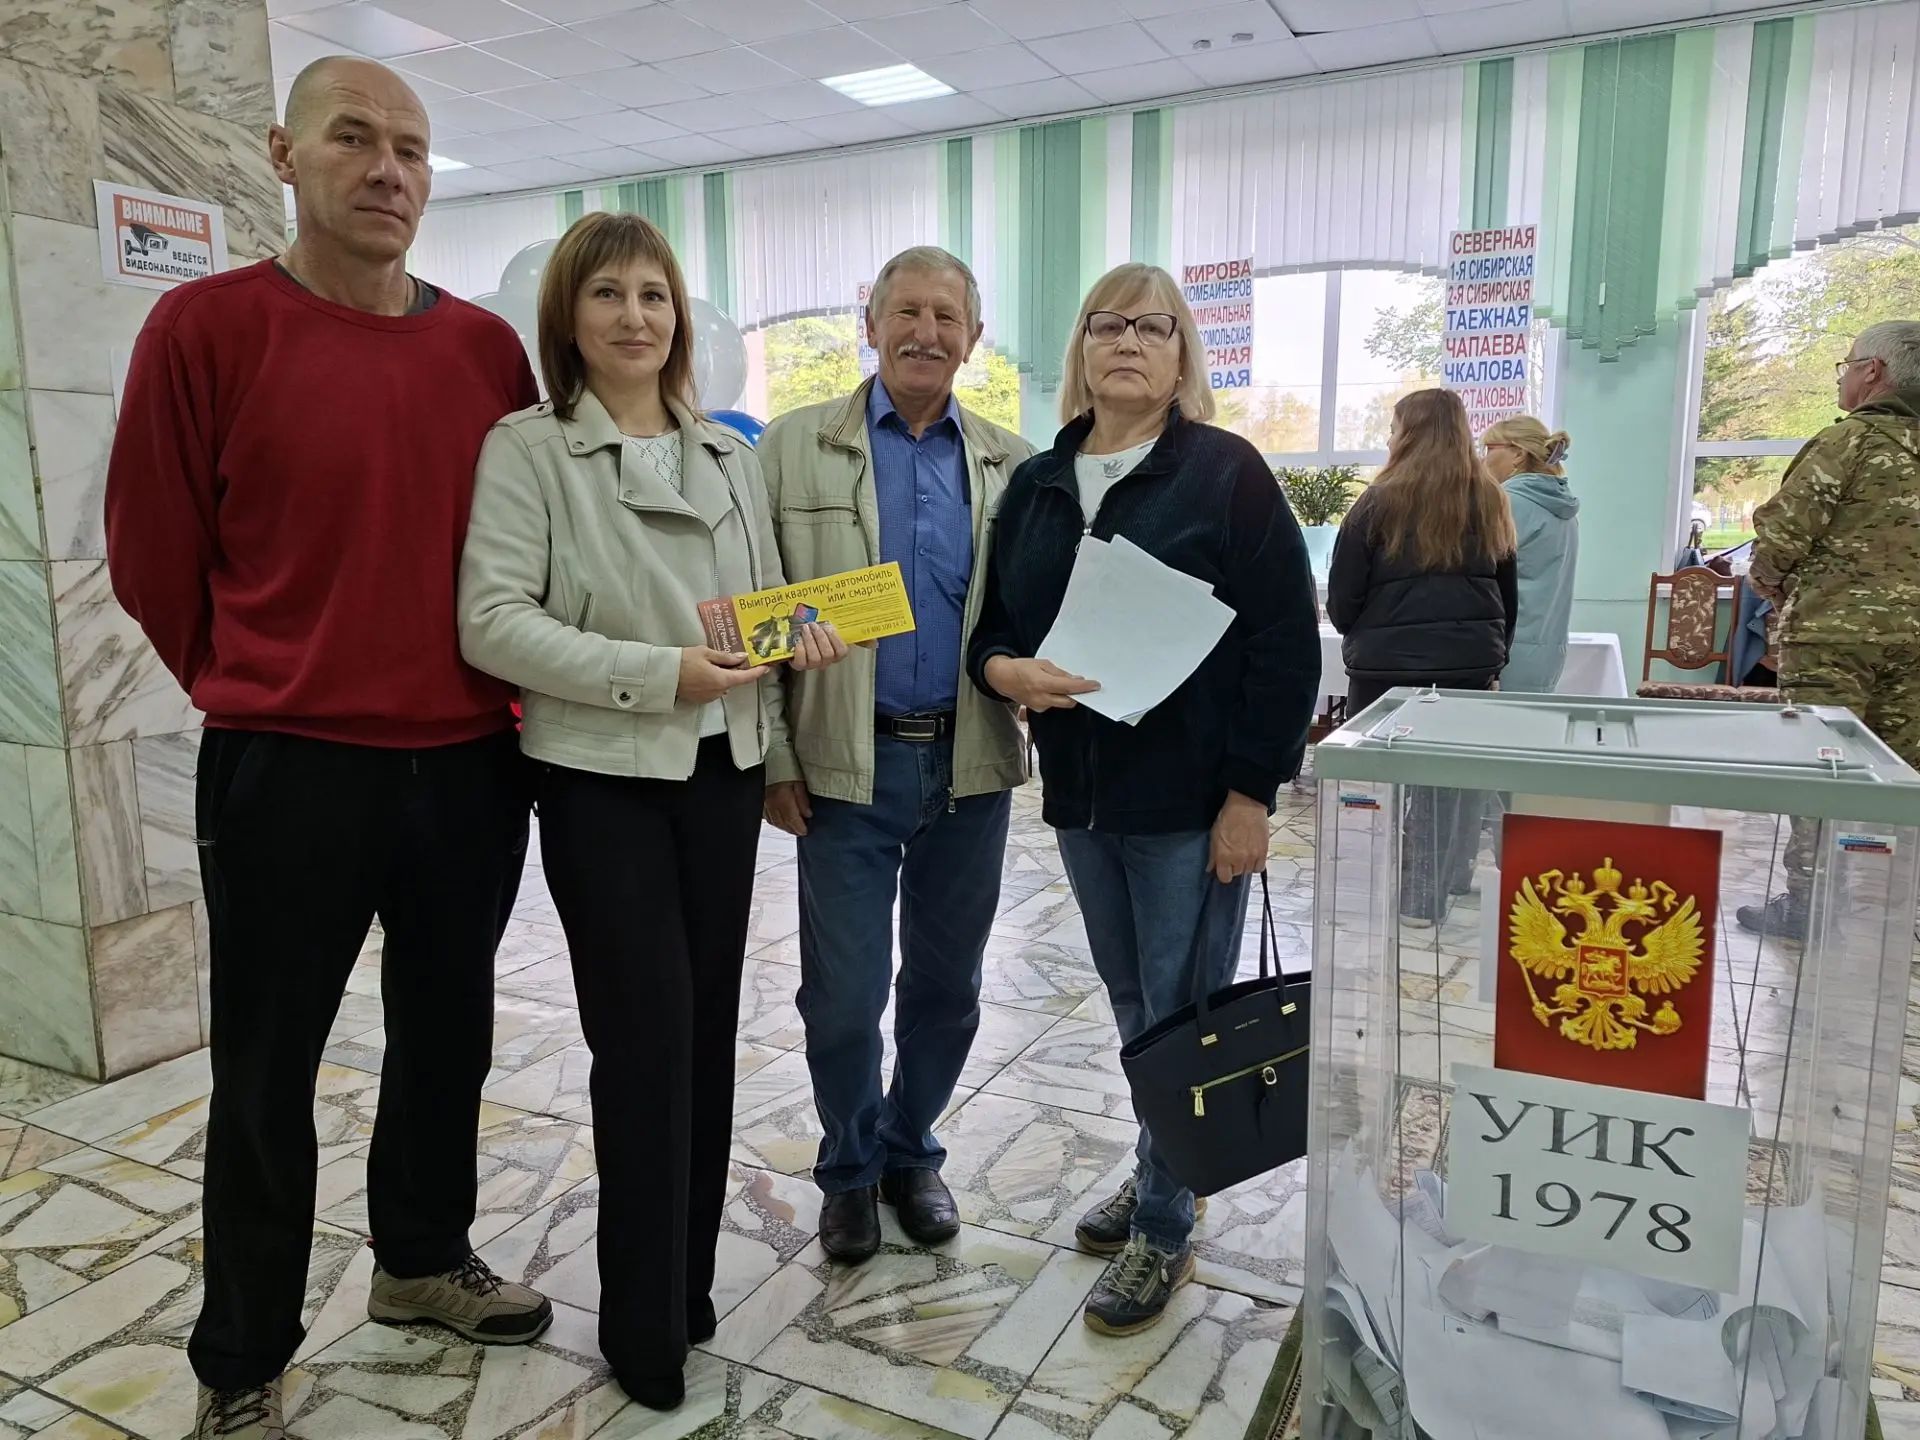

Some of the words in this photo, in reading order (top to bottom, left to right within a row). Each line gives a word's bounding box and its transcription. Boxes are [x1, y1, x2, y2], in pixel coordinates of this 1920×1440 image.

[121, 199, 204, 234] ВНИМАНИЕ
[1452, 227, 1535, 255] СЕВЕРНАЯ
[172, 250, 208, 266] ВЕДЁТСЯ
[1450, 260, 1466, 280] 1-Я
[1469, 255, 1533, 280] СИБИРСКАЯ
[1184, 259, 1252, 284] КИРОВА
[1448, 285, 1464, 305] 2-Я
[1467, 280, 1531, 304] СИБИРСКАЯ
[1447, 305, 1529, 331] ТАЕЖНАЯ
[1446, 333, 1527, 358] ЧАПАЕВА
[1444, 359, 1525, 382] ЧКАЛОВА
[738, 591, 783, 610] Выиграй
[785, 582, 833, 601] квартиру,
[835, 570, 893, 589] автомобиль
[828, 592, 846, 603] или
[849, 577, 898, 597] смартфон!
[1468, 1092, 1696, 1178] УИК
[1491, 1173, 1692, 1253] 1978
